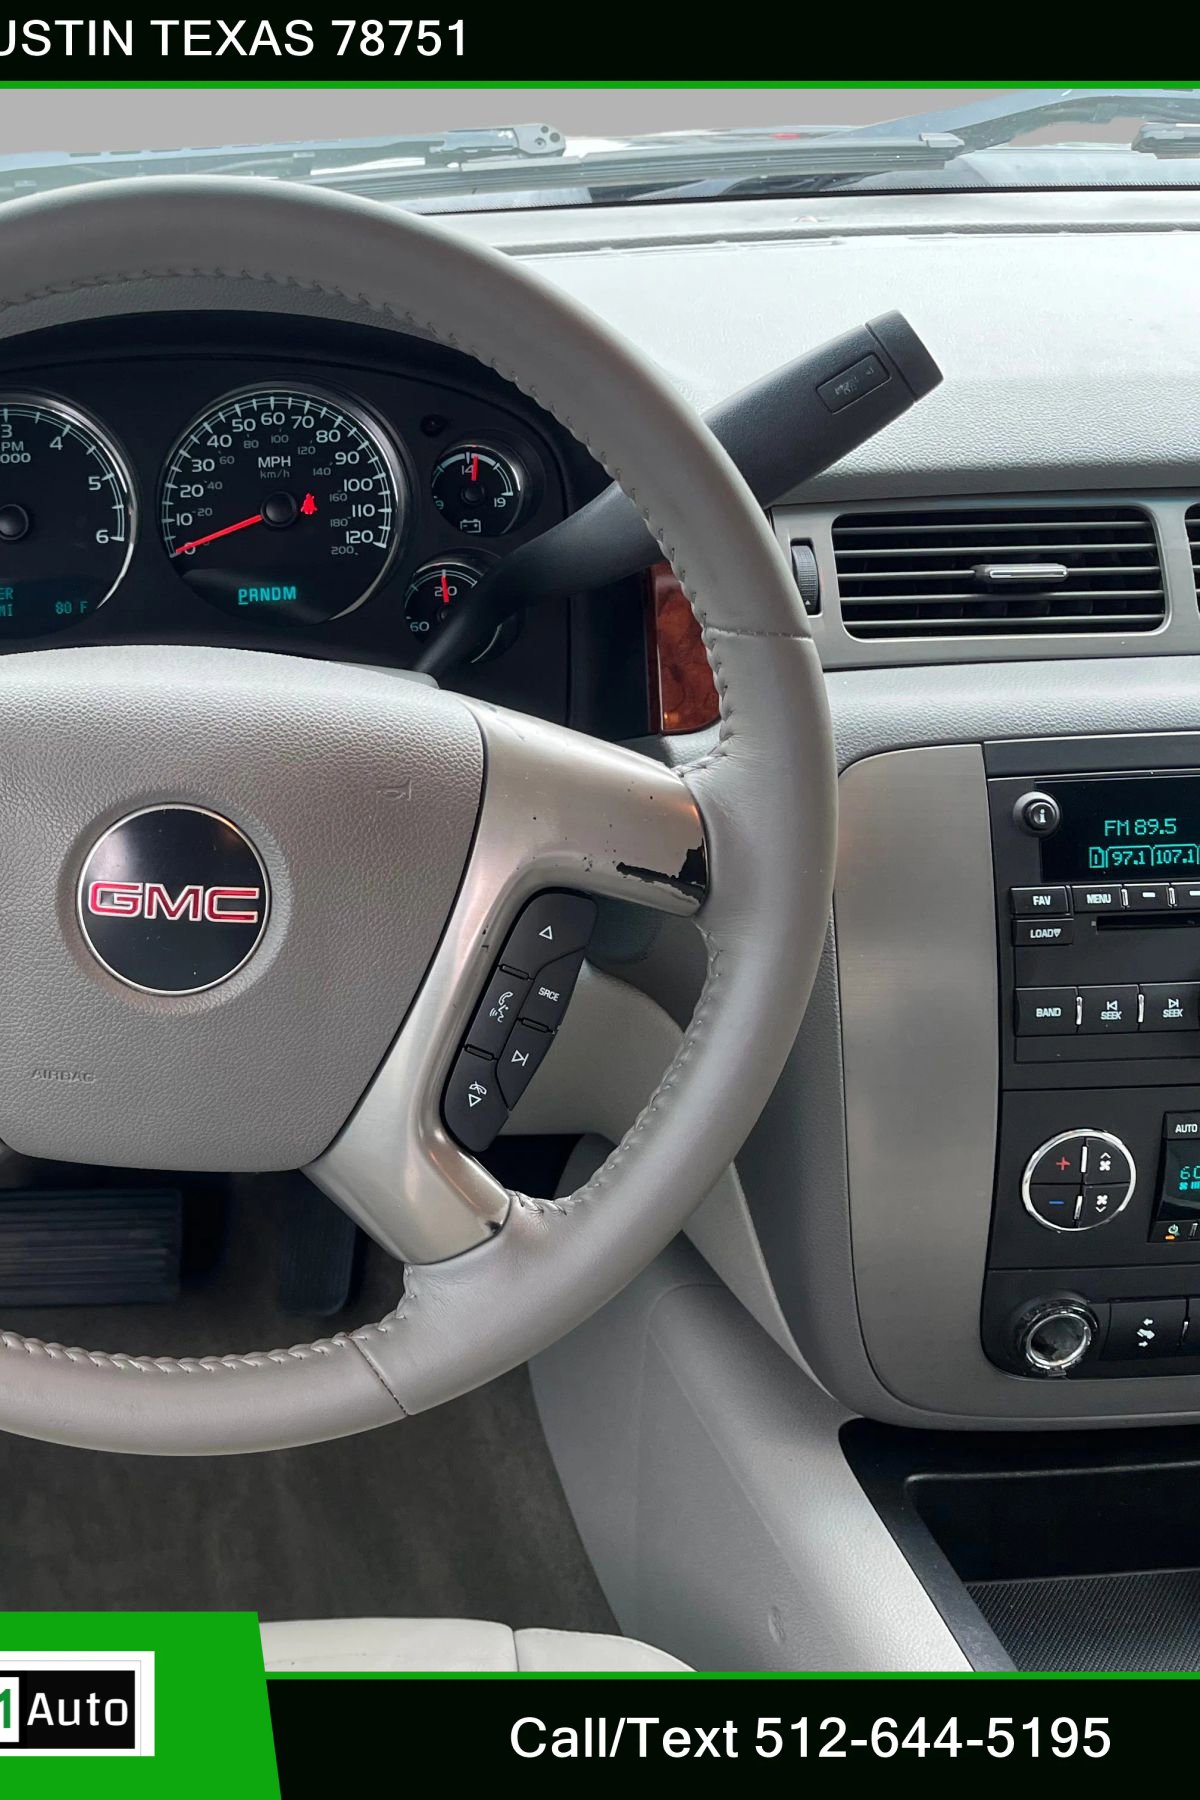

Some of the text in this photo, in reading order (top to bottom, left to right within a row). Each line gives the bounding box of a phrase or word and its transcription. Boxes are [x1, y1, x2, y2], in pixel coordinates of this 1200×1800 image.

[231, 417, 257, 433] 50
[260, 411, 285, 426] 60
[290, 415, 315, 430] 70
[0, 423, 14, 439] 3
[315, 429, 341, 444] 80
[48, 436, 64, 451] 4
[206, 434, 233, 449] 40
[242, 439, 260, 450] 80
[270, 433, 290, 445] 100
[296, 445, 317, 456] 120
[334, 450, 361, 466] 90
[190, 458, 216, 473] 30
[218, 454, 236, 466] 60
[257, 455, 292, 469] MPH
[259, 468, 291, 480] km/h
[312, 467, 332, 478] 140
[88, 476, 102, 491] 5
[180, 483, 205, 499] 20
[206, 480, 224, 491] 40
[343, 478, 374, 493] 100
[351, 504, 376, 517] 110
[493, 497, 507, 509] 19
[176, 512, 193, 527] 10
[95, 529, 110, 544] 6
[346, 530, 374, 545] 120
[237, 585, 297, 605] PRNDM
[55, 600, 88, 615] 80 F
[1104, 818, 1177, 836] FM 89.5
[1111, 848, 1195, 866] 97.1 107.1
[89, 880, 261, 924] GMC
[1032, 895, 1052, 907] FAV
[1086, 893, 1112, 905] MENU
[1030, 928, 1054, 939] LOAD
[538, 987, 560, 1002] SRCE
[1035, 1007, 1062, 1019] BAND
[1100, 1011, 1122, 1020] SEEK
[1162, 1008, 1183, 1018] SEEK
[31, 1068, 96, 1084] AIRBAG
[1175, 1124, 1199, 1133] AUTO
